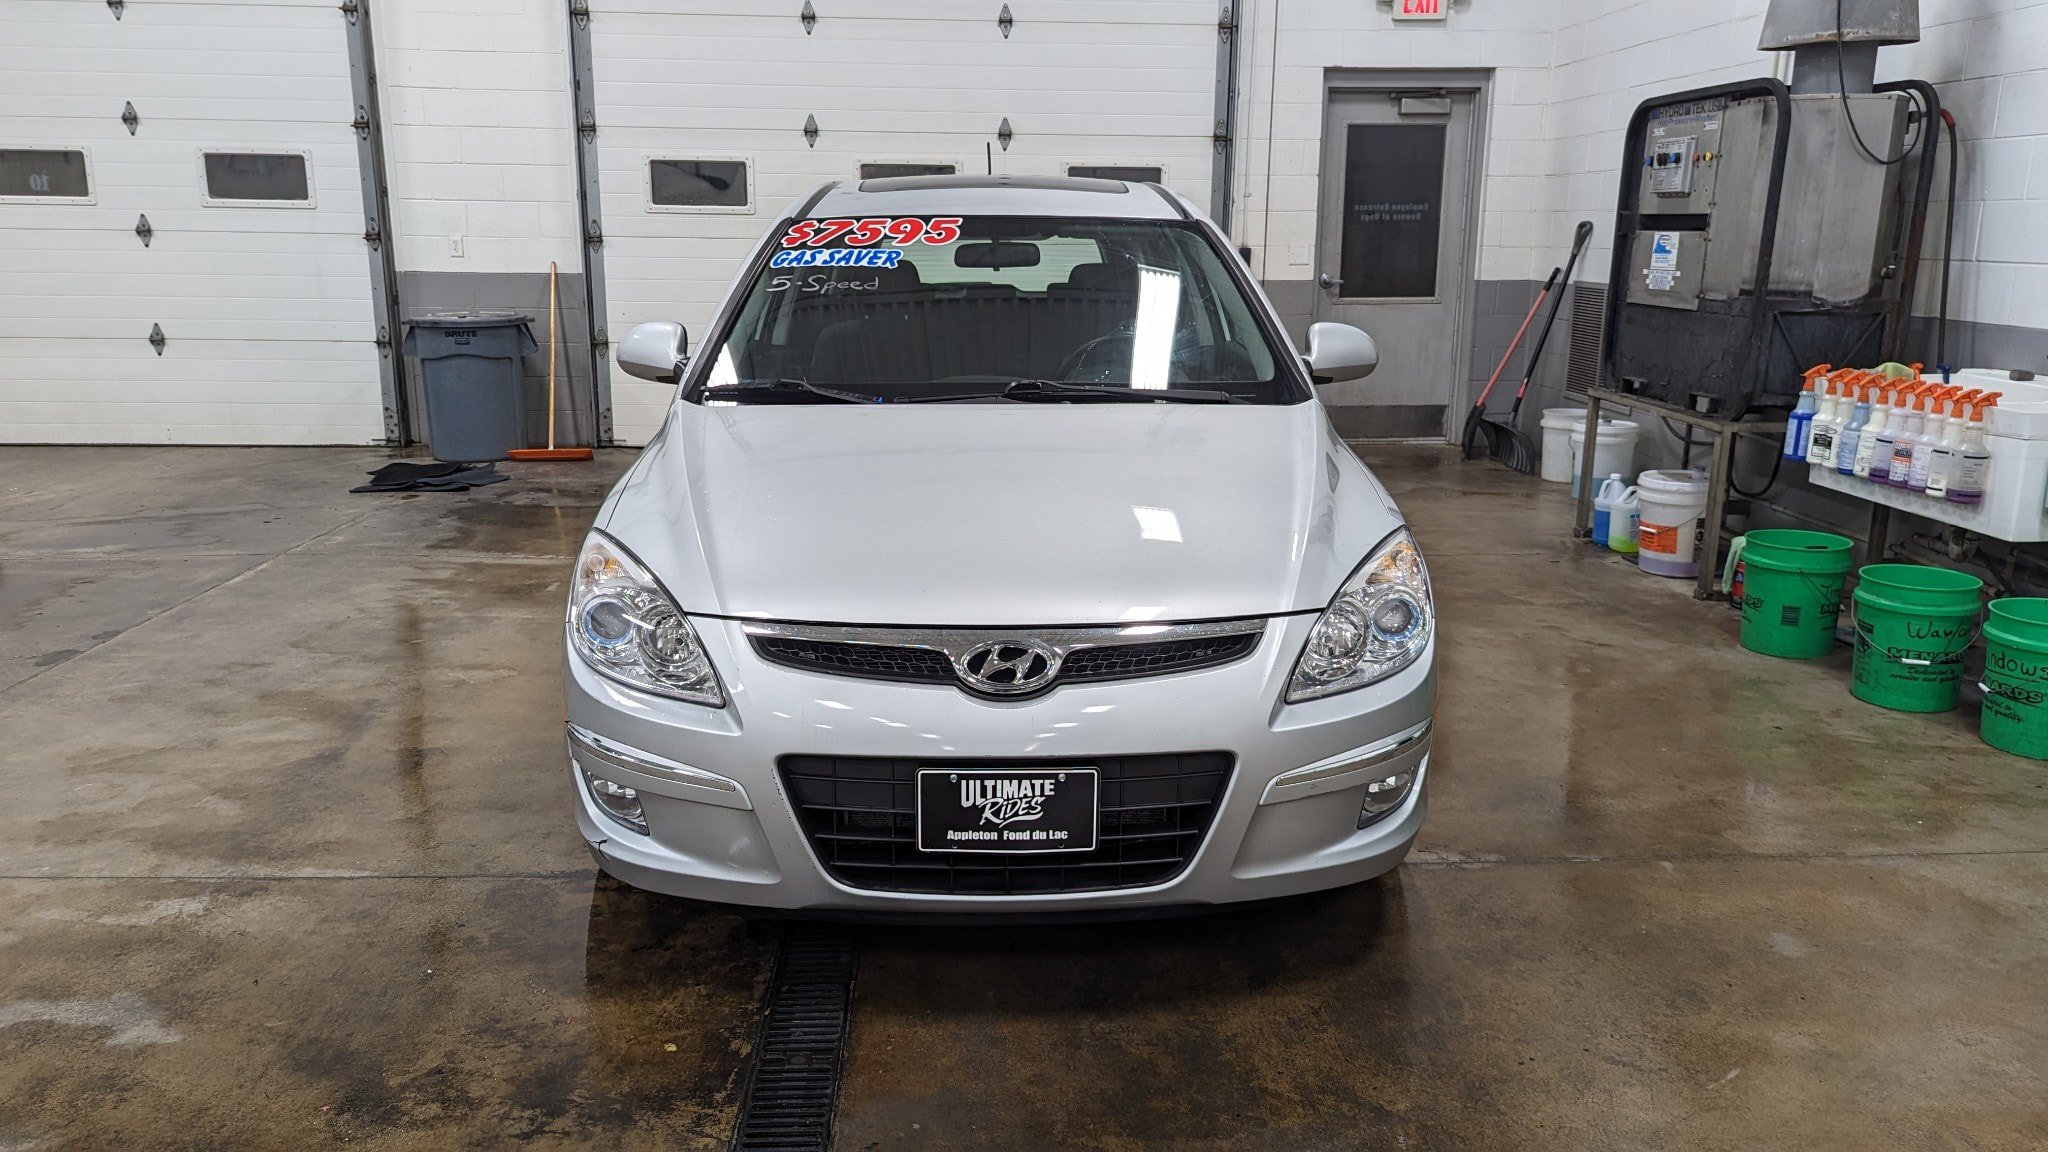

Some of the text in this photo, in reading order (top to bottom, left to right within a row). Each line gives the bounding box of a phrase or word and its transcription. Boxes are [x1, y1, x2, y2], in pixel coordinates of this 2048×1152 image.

[781, 217, 963, 247] $7595
[770, 248, 903, 269] GAS SAVER
[766, 275, 879, 295] 5-Speed
[444, 330, 478, 338] BRUTE
[961, 779, 1055, 808] ULTIMATE
[947, 830, 1068, 841] Appleton Fond du Lac
